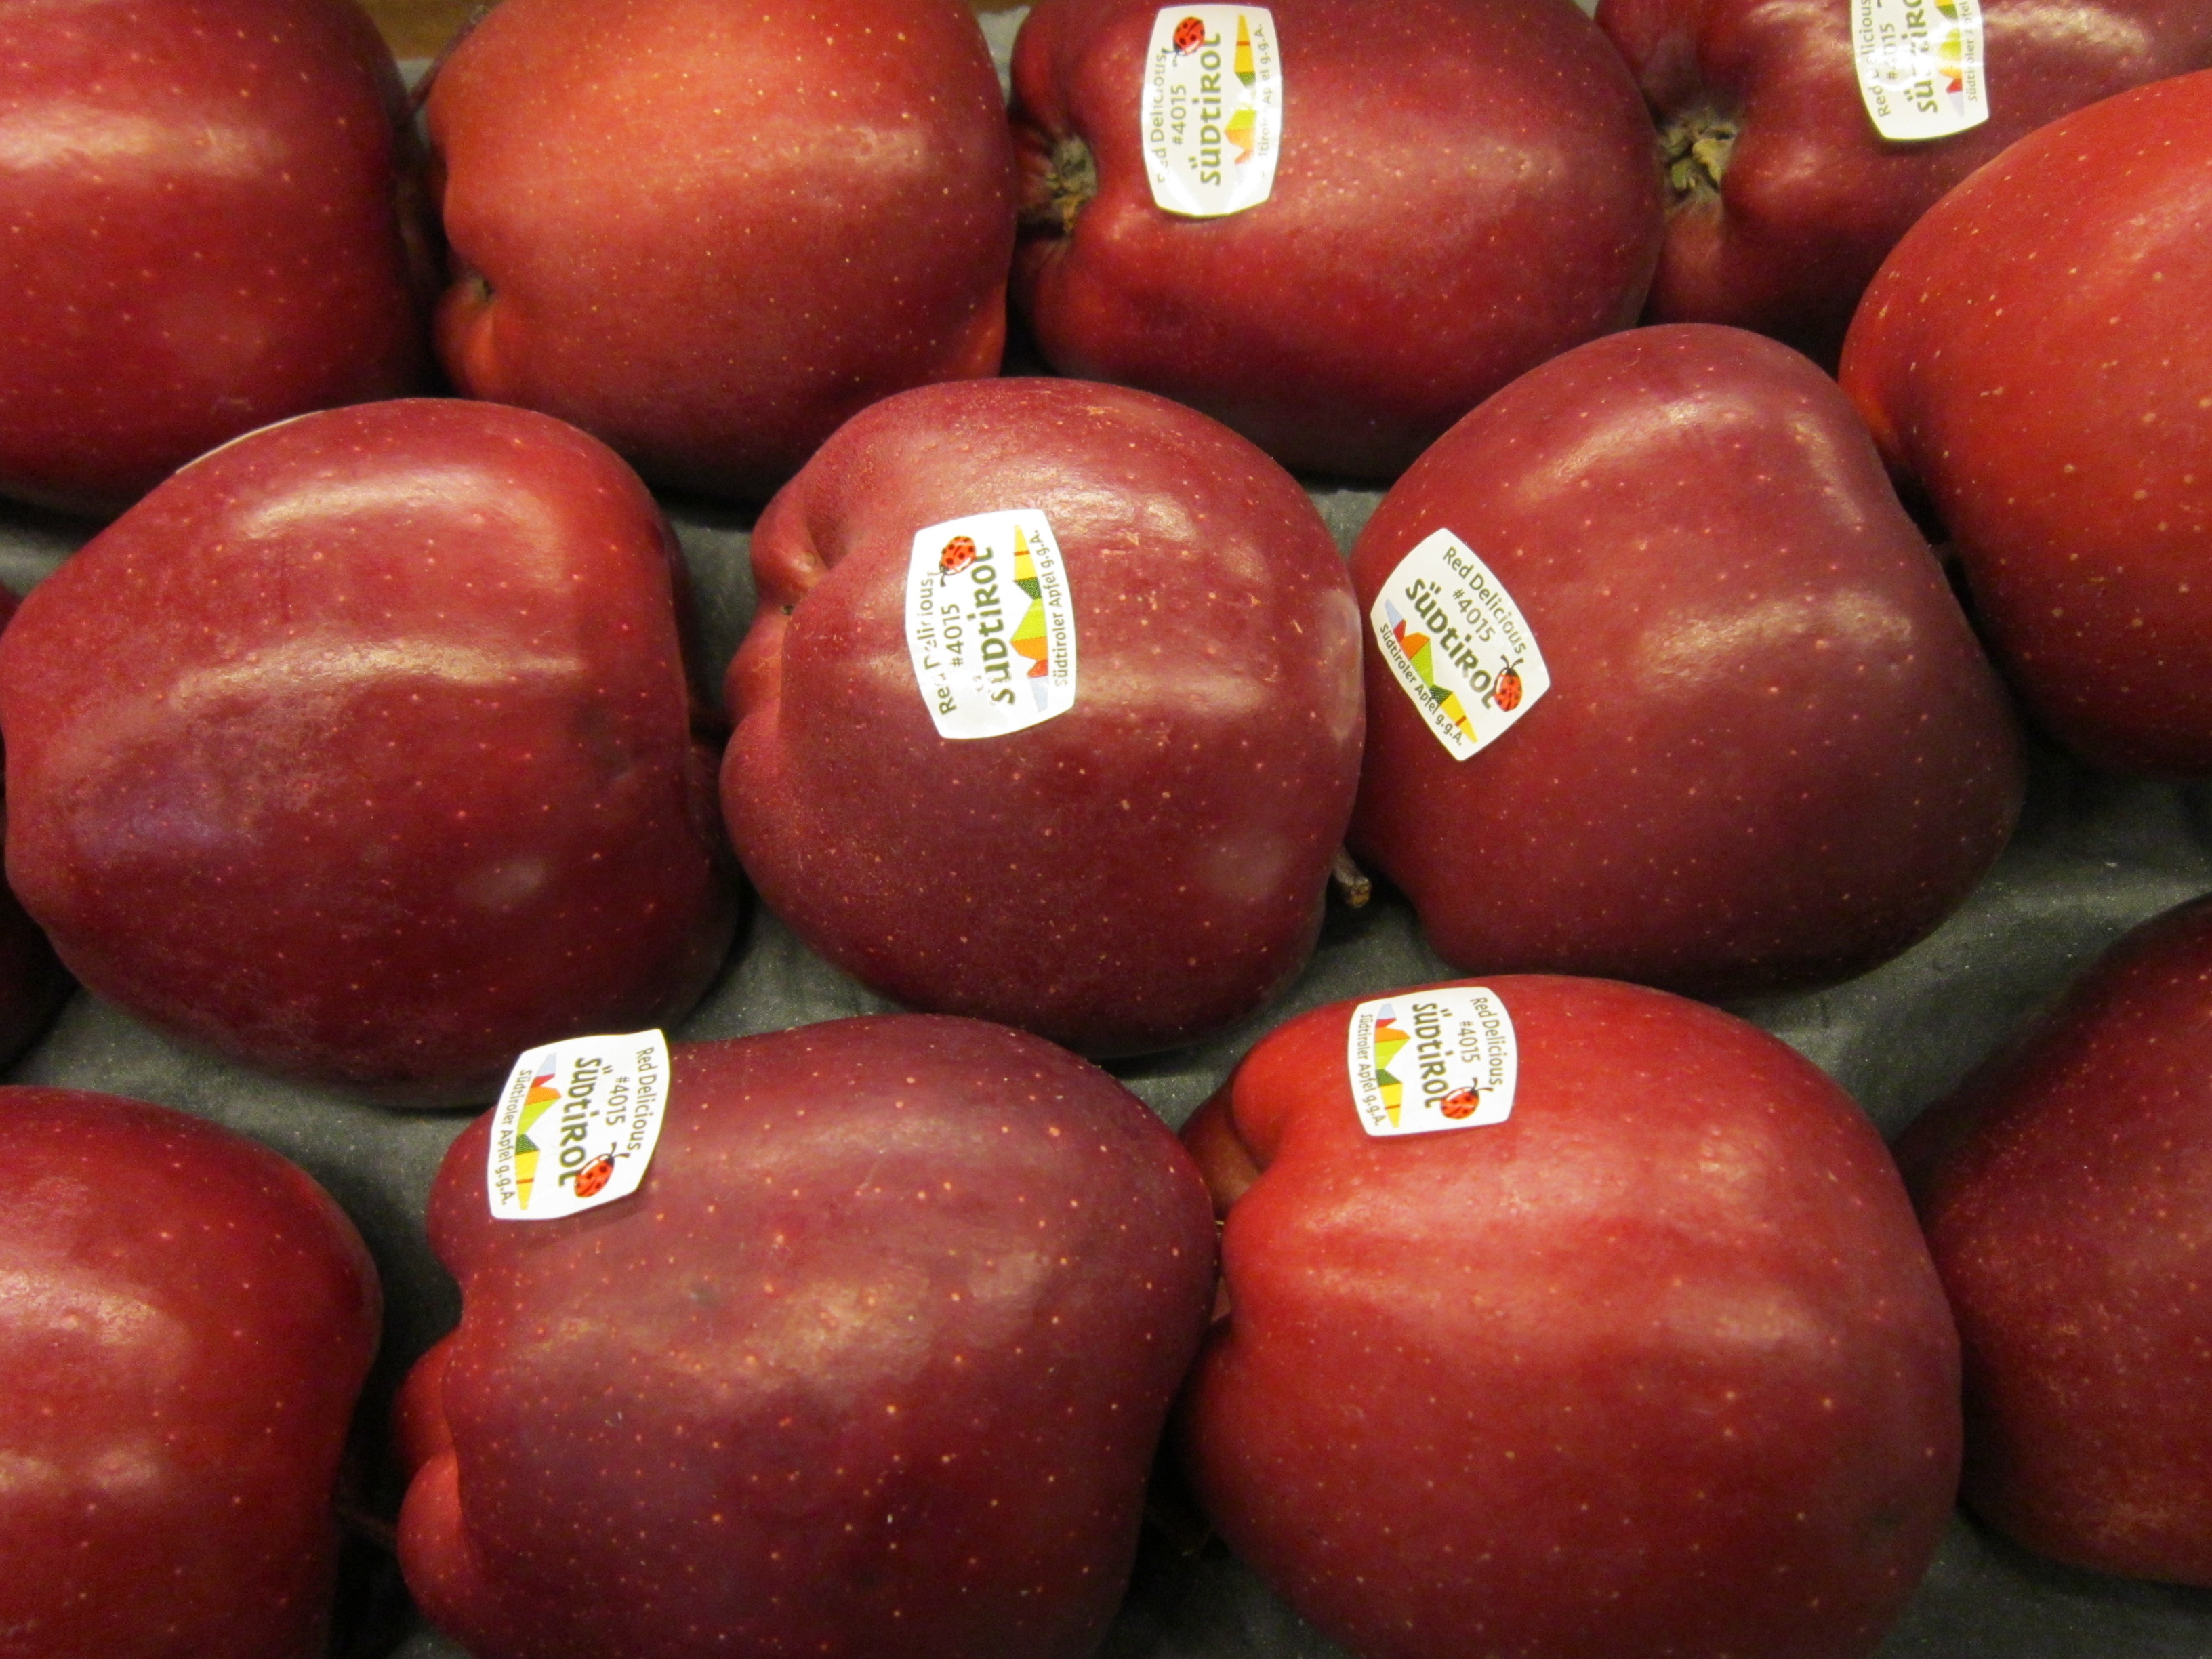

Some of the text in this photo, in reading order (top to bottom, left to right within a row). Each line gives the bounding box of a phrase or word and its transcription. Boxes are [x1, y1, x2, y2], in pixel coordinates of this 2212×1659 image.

[1170, 84, 1187, 145] #4015
[1262, 69, 1273, 104] Apel
[1868, 85, 1891, 117] Red
[941, 603, 964, 668] #4015
[1029, 529, 1068, 688] Südtiroler Apfel g.g.A.
[1442, 545, 1527, 655] Red Delicious
[1452, 588, 1496, 643] #4015
[1379, 623, 1462, 746] Südtiroler Apfel g.g.A.
[1357, 1013, 1387, 1126] Südtiroler Apfel g.g.A.
[1458, 1021, 1481, 1063] #4015
[1470, 996, 1508, 1086] Red Delicious
[495, 1069, 533, 1205] Südtiroler Apfel g.g.A.
[605, 1076, 630, 1126] #4015
[626, 1046, 658, 1151] Red Delicious
